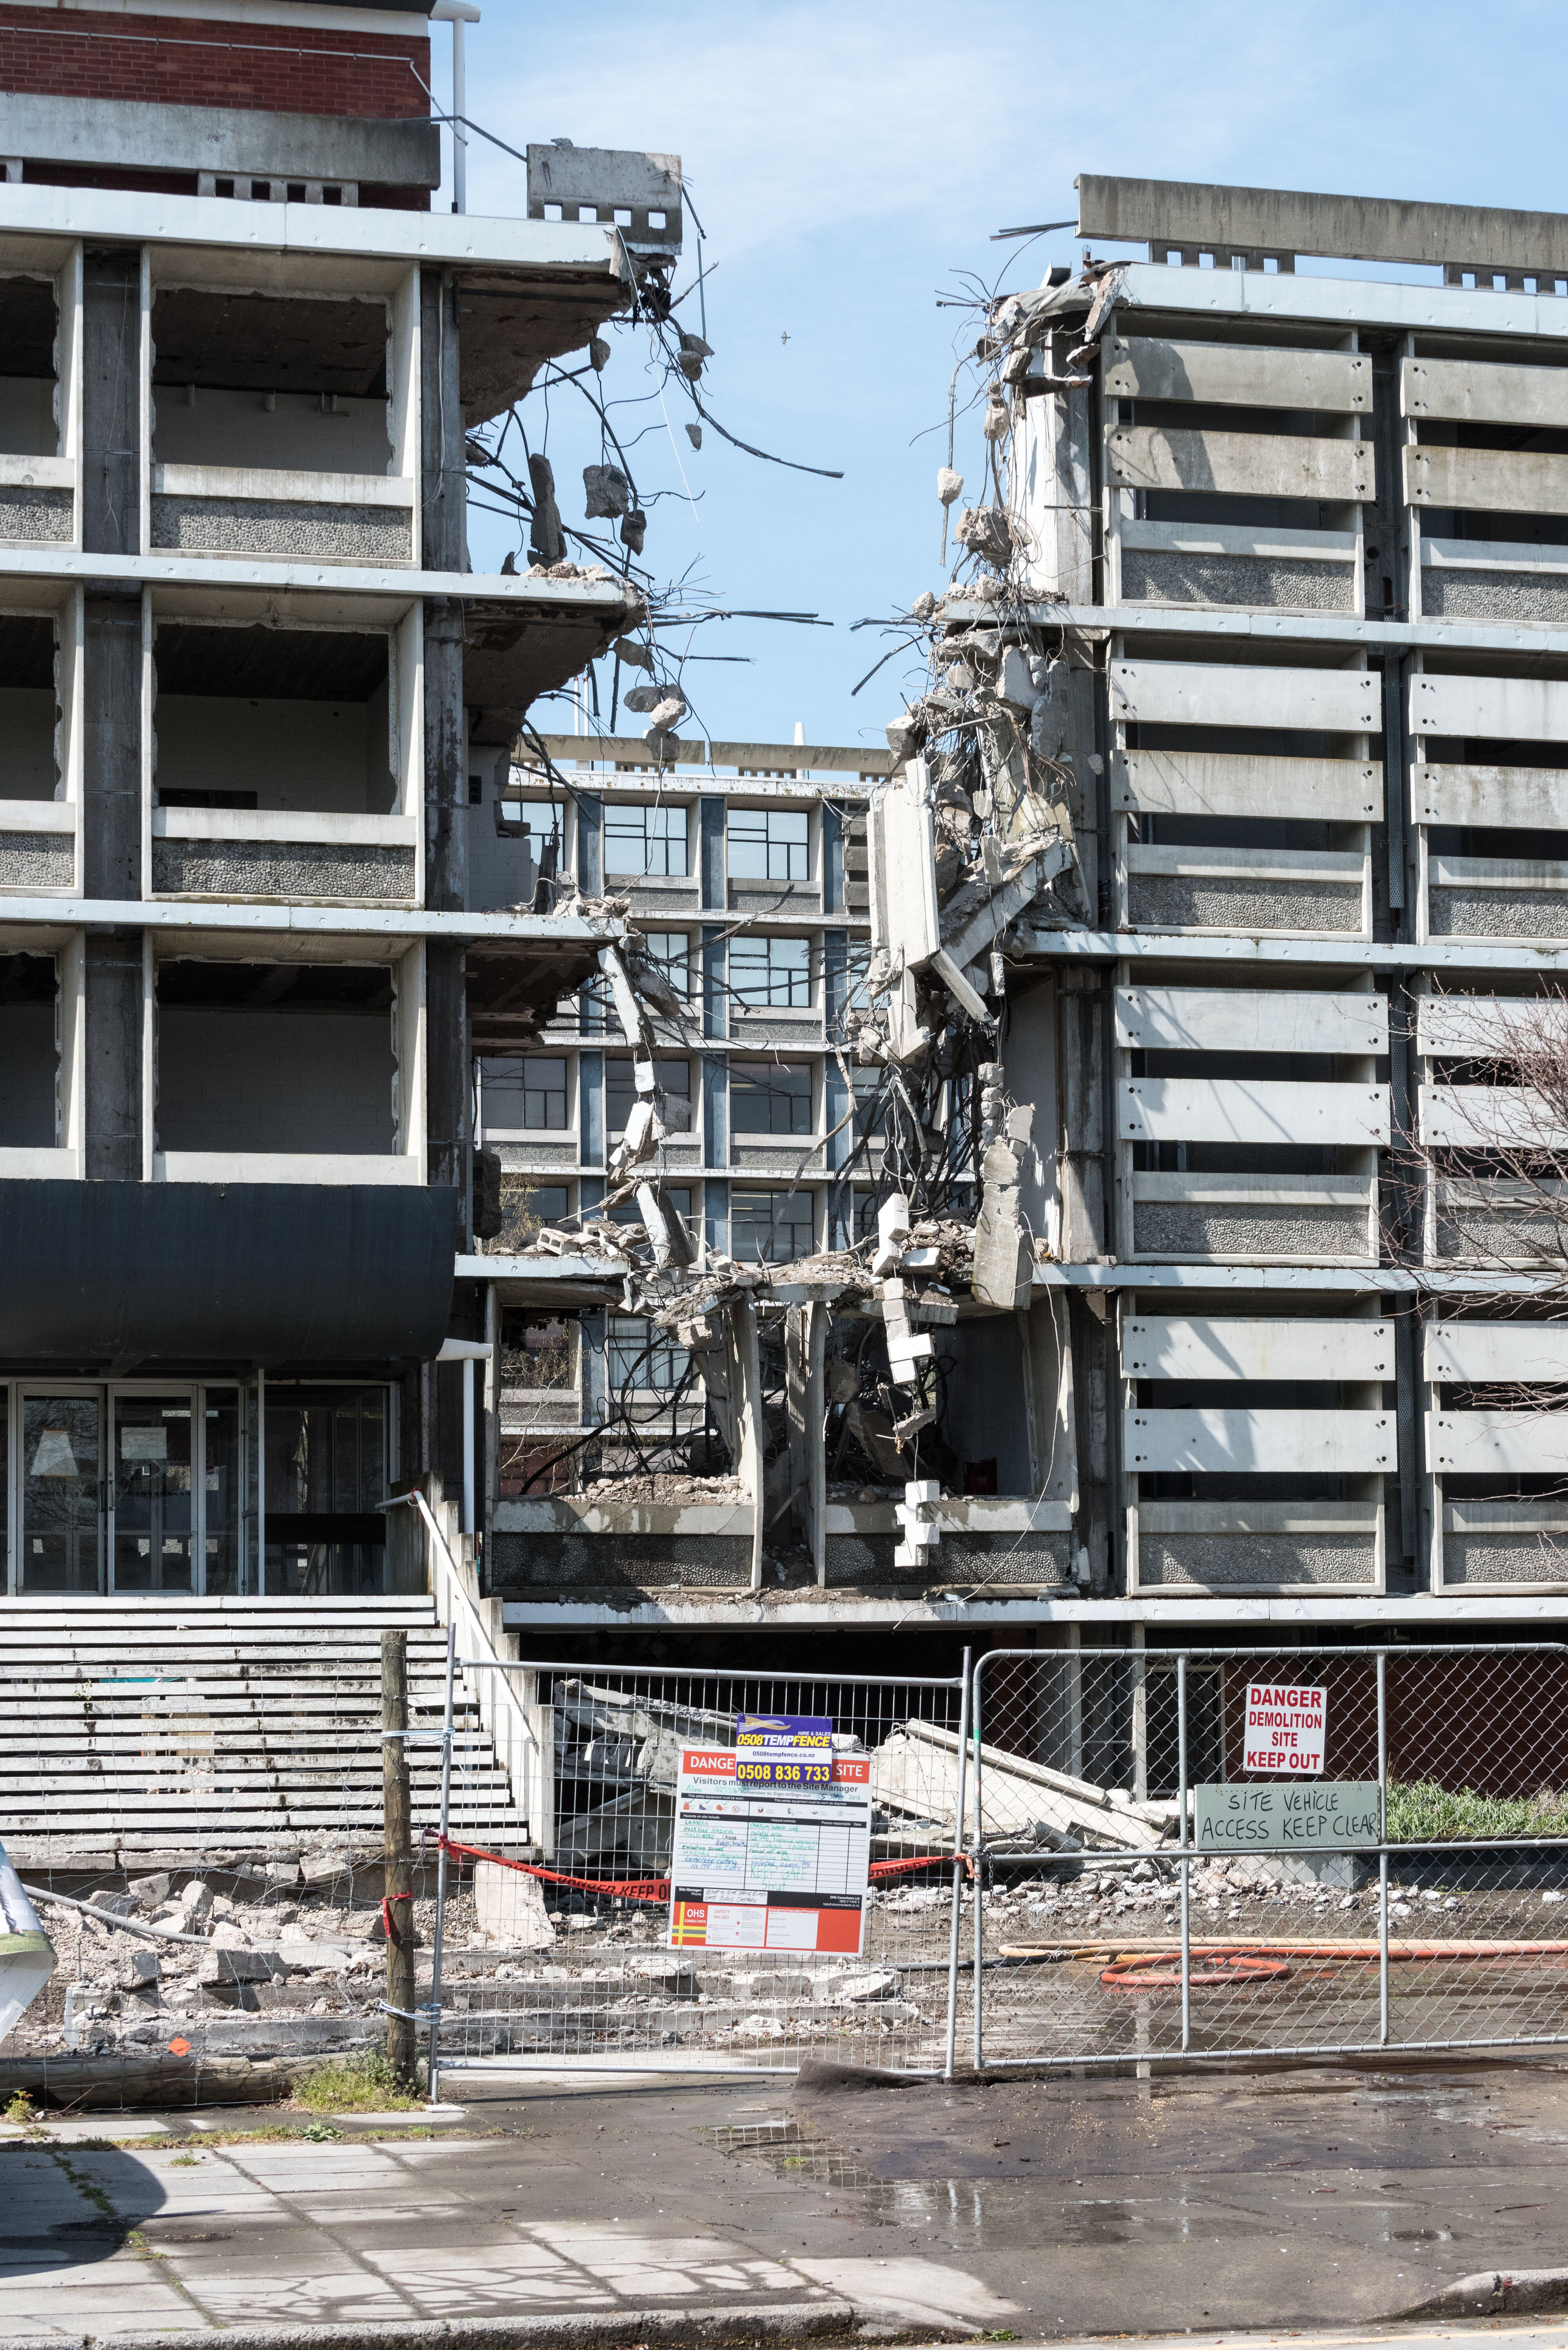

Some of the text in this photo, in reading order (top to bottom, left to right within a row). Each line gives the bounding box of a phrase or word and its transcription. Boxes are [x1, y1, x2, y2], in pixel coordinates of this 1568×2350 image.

[1250, 1688, 1322, 1708] DANGER
[1249, 1711, 1322, 1729] DEMOLITION
[737, 1734, 831, 1747] 0508TEMPFENCE
[1271, 1731, 1298, 1747] SITE
[690, 1756, 863, 1777] DANGE SITE
[1247, 1751, 1320, 1769] KEEP OUT
[737, 1764, 830, 1781] 0508 836 733
[693, 1777, 727, 1785] Visitors
[748, 1781, 777, 1789] report
[821, 1784, 858, 1793] Manager
[1201, 1812, 1379, 1841] ACCESS KEEP CLEAR
[620, 1885, 655, 1899] KEEP
[687, 1909, 705, 1918] OHS
